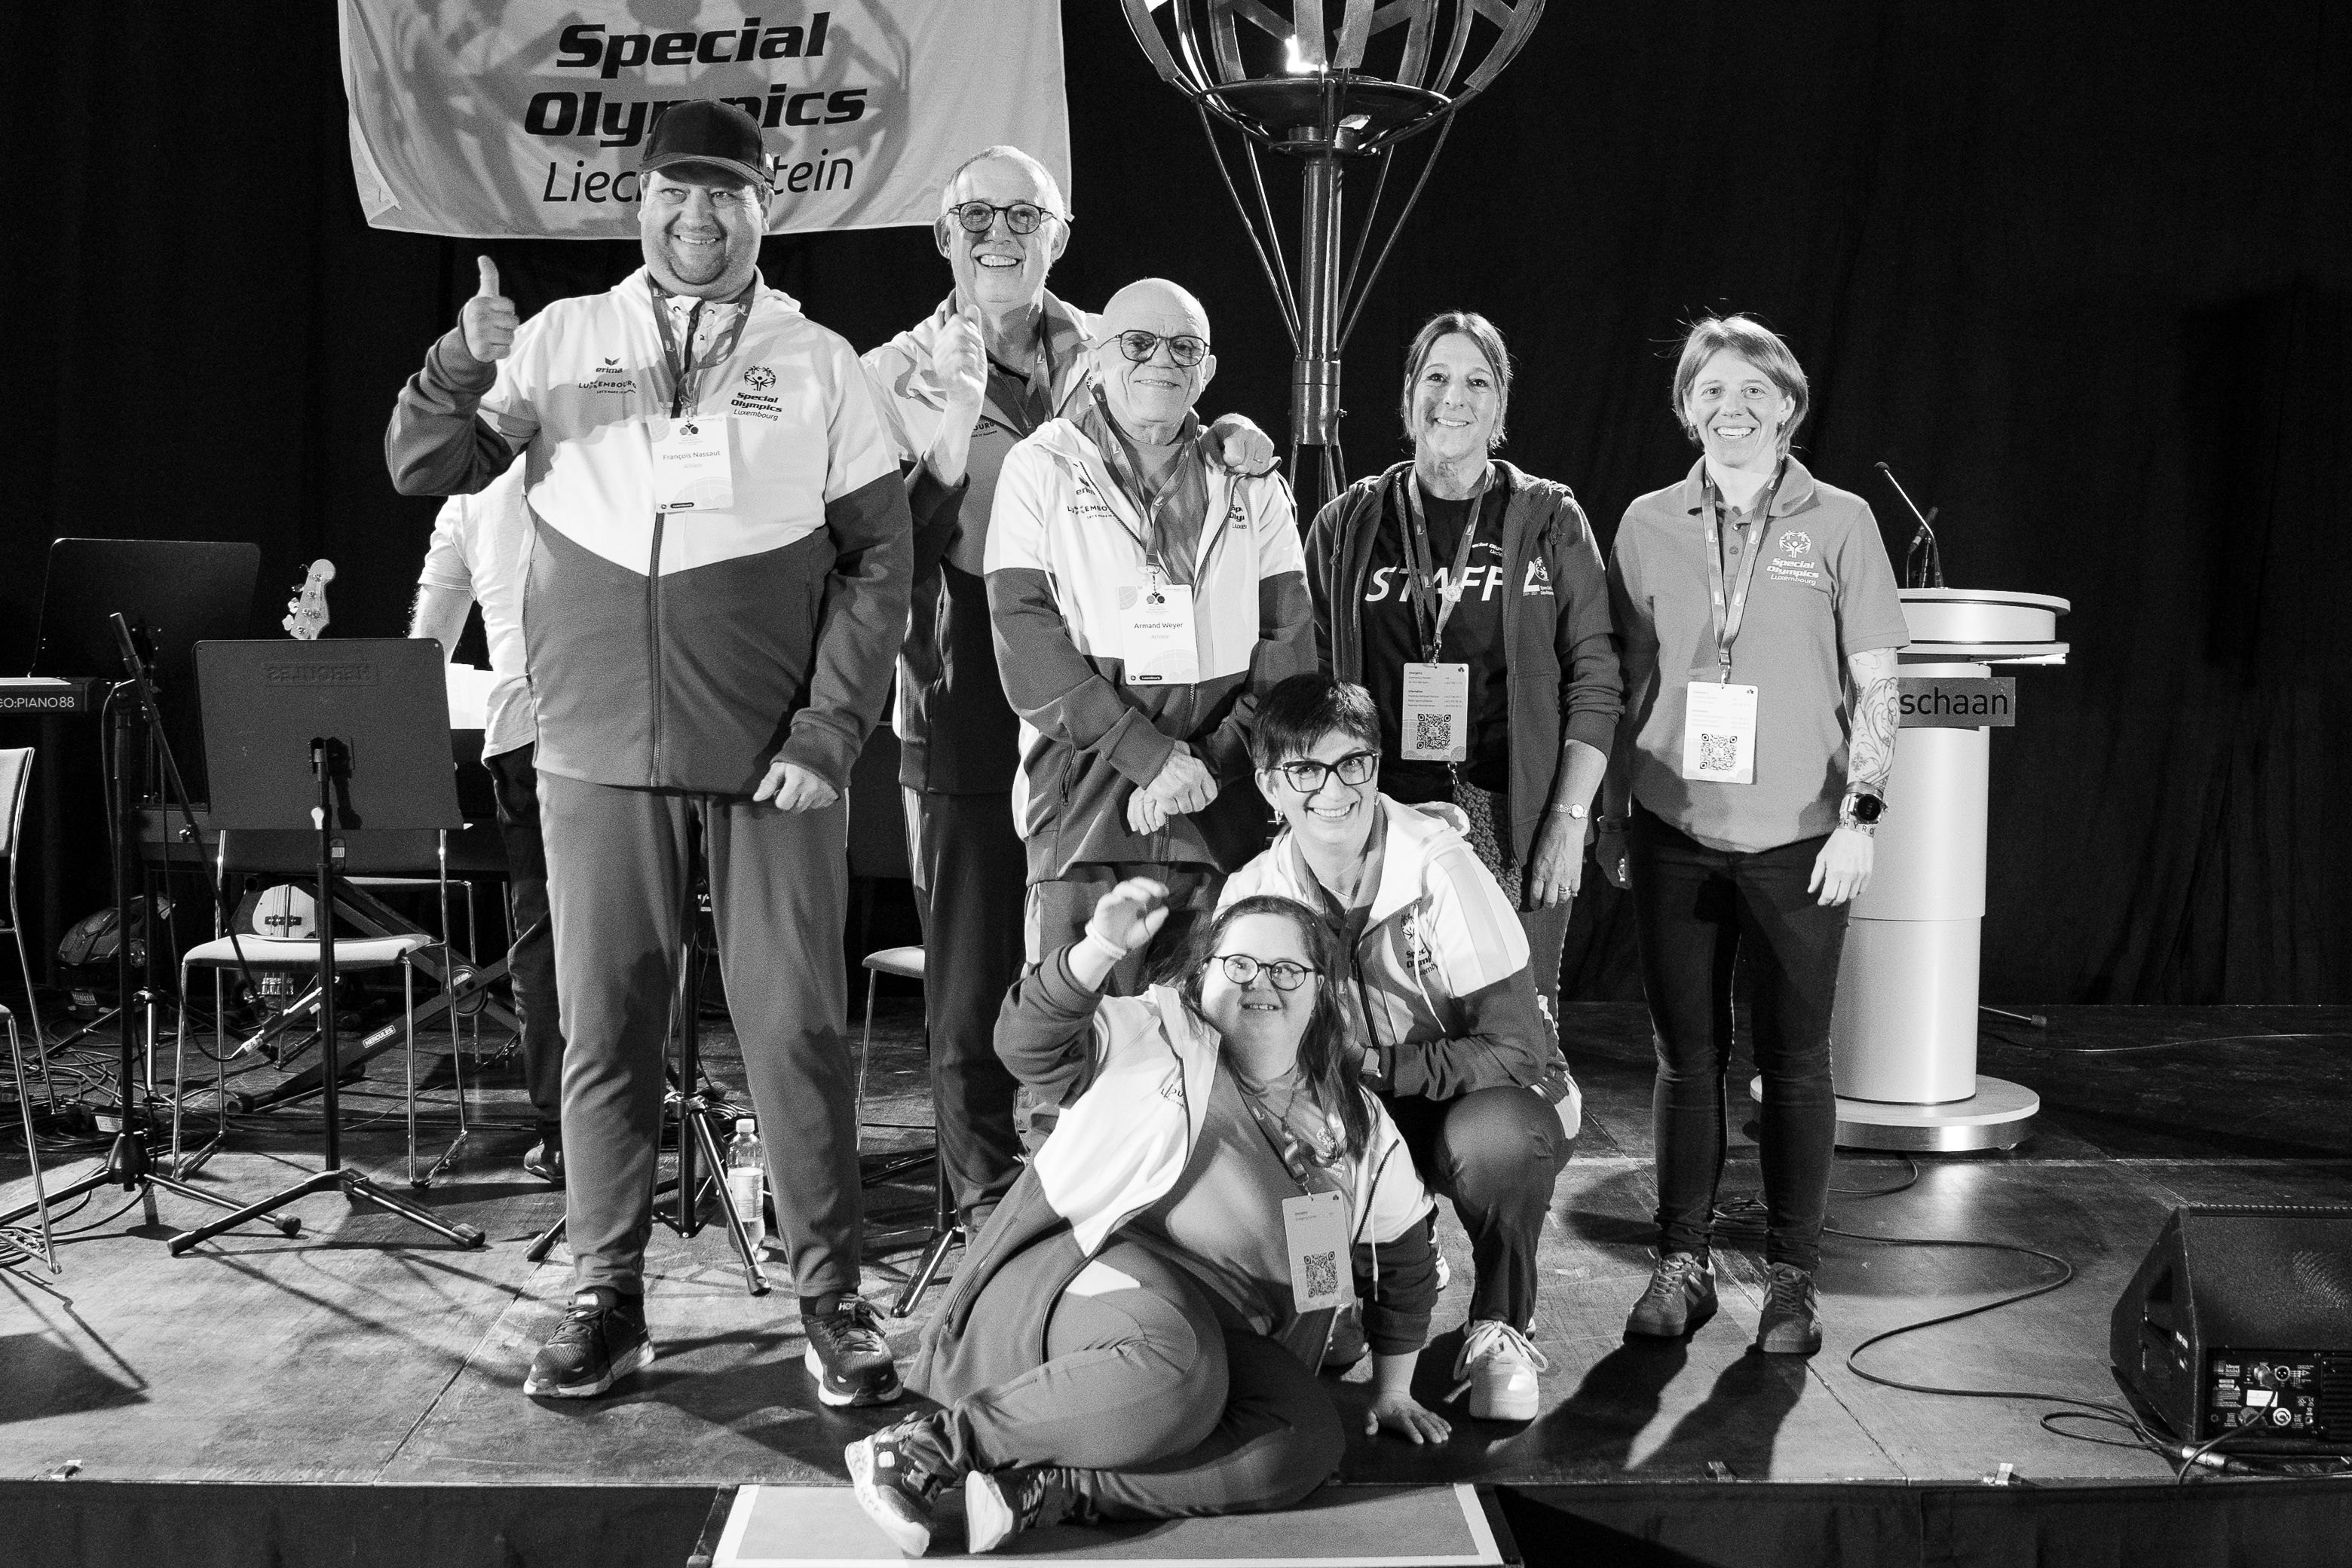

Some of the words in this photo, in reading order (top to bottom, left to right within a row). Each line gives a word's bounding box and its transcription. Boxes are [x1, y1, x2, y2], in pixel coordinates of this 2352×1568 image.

[556, 11, 831, 79] Special
[524, 84, 868, 147] Olyics
[543, 149, 853, 204] Liectein
[737, 392, 779, 403] Special
[730, 399, 782, 412] Olympics
[733, 409, 779, 421] Luxembourg
[1772, 558, 1815, 569] Special
[1766, 565, 1820, 578] Olympics
[1770, 573, 1817, 586] Luxembourg
[1899, 686, 2008, 715] schaan
[364, 1027, 394, 1046] HERCULES
